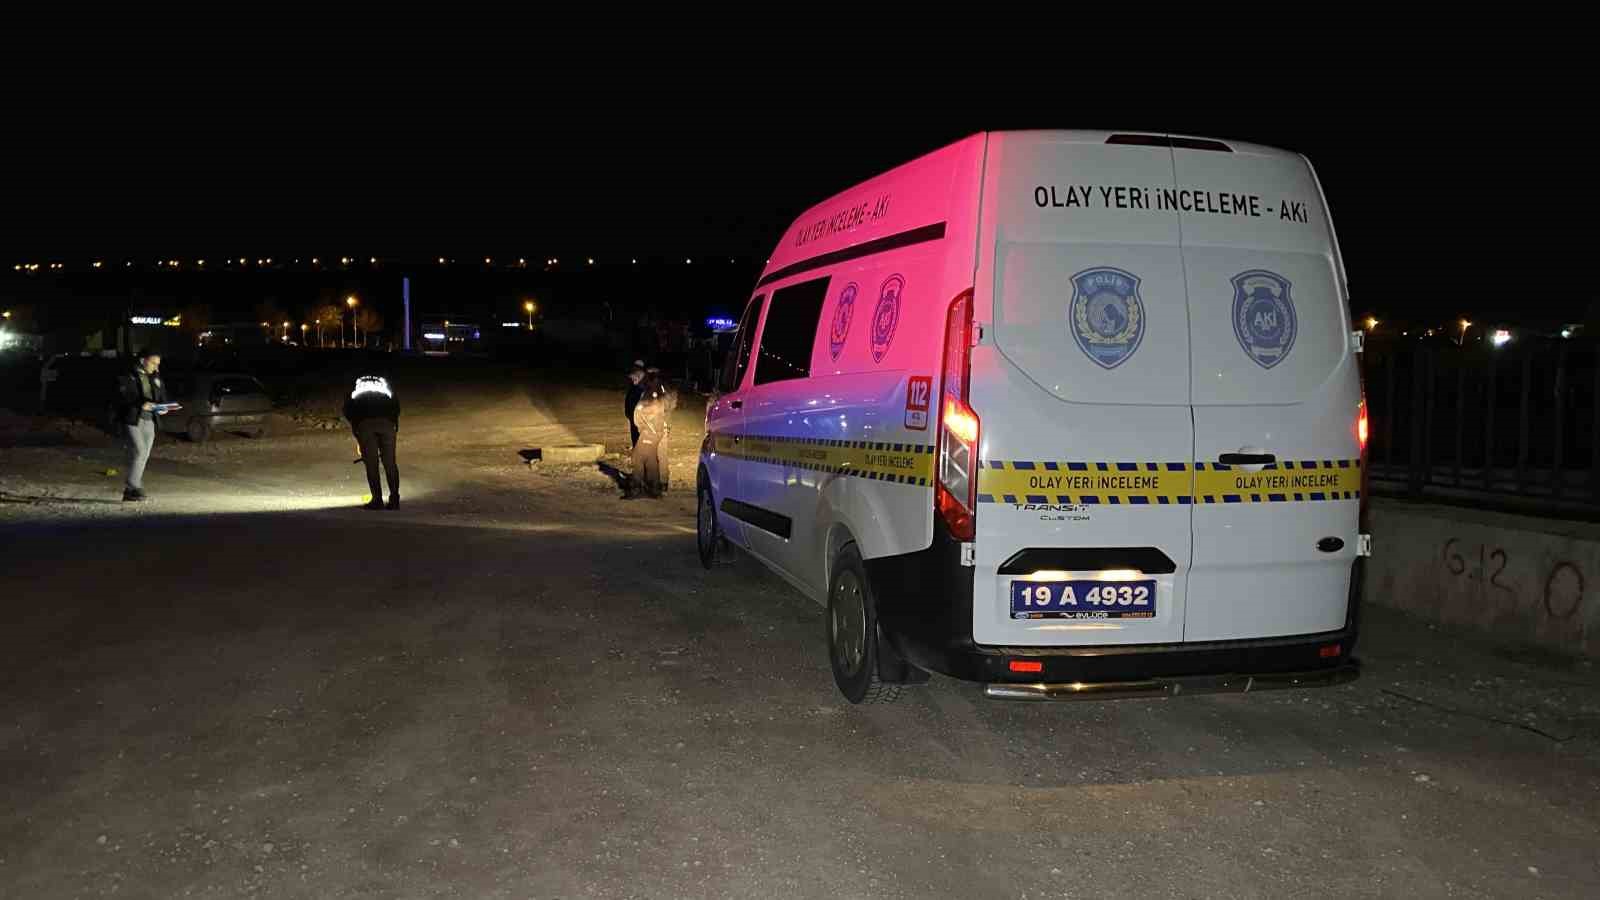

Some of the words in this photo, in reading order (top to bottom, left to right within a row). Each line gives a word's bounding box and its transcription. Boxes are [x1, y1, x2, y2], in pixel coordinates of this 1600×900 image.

[1034, 186, 1092, 208] OLAY
[910, 380, 928, 406] 112
[1030, 476, 1062, 489] OLAY
[1236, 476, 1263, 489] OLAY
[1021, 586, 1052, 606] 19
[1059, 586, 1078, 606] A
[1085, 586, 1149, 606] 4932
